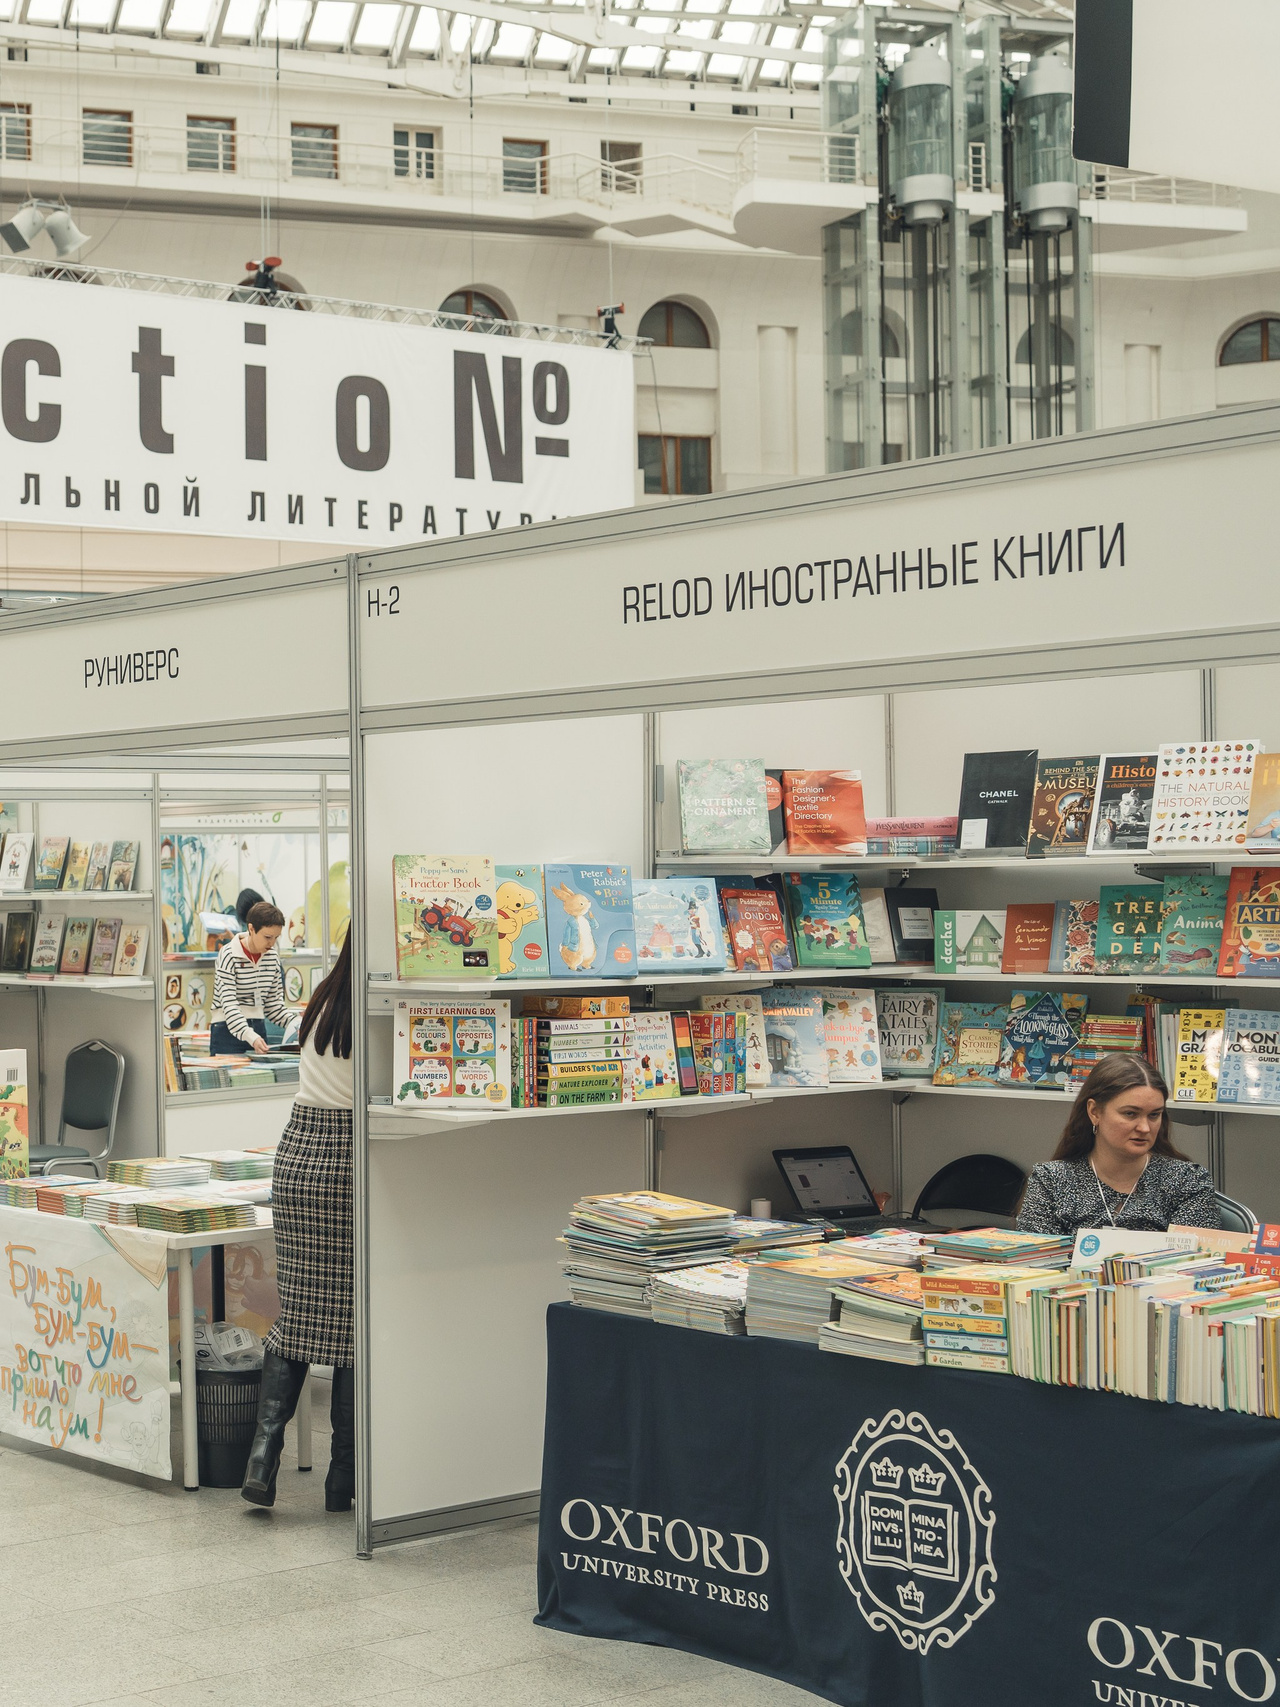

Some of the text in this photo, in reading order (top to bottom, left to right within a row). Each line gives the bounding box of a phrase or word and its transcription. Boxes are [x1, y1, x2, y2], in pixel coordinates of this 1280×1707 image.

[248, 490, 558, 536] ЛИТЕРАТУ
[623, 522, 1125, 624] RELOD ИНОСТРАННЫЕ КНИГИ
[84, 647, 179, 688] РУНИВЕРС
[1109, 765, 1156, 779] Histo
[791, 777, 807, 785] The
[792, 786, 824, 794] Fashion
[1160, 783, 1184, 794] THE
[1188, 781, 1250, 793] NATURAL
[792, 794, 836, 804] Designer's
[979, 789, 1019, 799] CHANEL
[694, 797, 756, 806] PATTERN &
[1157, 795, 1249, 808] HISTORY BOOK
[694, 806, 758, 816] ORNAMENT
[794, 812, 833, 821] Directory
[580, 870, 604, 879] Peter
[409, 877, 482, 888] Tractor Book
[593, 878, 627, 887] Rabbit's
[603, 888, 623, 898] Box
[817, 882, 831, 899] 5
[611, 897, 630, 907] Fun
[739, 898, 775, 907] Paddington's
[810, 897, 843, 905] Minute
[740, 913, 779, 921] LONDON
[940, 921, 953, 965] dacha
[882, 999, 922, 1016] FAIRY
[889, 1014, 928, 1029] TALES
[1028, 1012, 1051, 1021] Through
[1051, 1013, 1060, 1021] the
[553, 1039, 579, 1047] NUMBERS
[880, 1031, 924, 1047] MYTHS
[1236, 1031, 1277, 1045] MON
[638, 1043, 667, 1051] Activities
[961, 1040, 998, 1049] STORIES
[560, 1063, 619, 1073] BUILDER'S Tool Kit
[559, 1079, 609, 1089] NATURE EXPLORER
[559, 1092, 606, 1104] ON THE FARM
[1177, 1089, 1194, 1097] CLE
[1084, 1241, 1096, 1250] BIG
[1177, 1237, 1192, 1245] VERY
[1167, 1243, 1191, 1251] HUNGRY
[1249, 1264, 1268, 1275] the
[938, 1282, 960, 1290] Animals
[928, 1320, 944, 1328] Things
[943, 1339, 960, 1348] Bugs
[939, 1356, 963, 1366] Garden
[870, 1505, 903, 1522] DOMI
[911, 1512, 947, 1530] MINA
[560, 1498, 770, 1578] OXFORD
[874, 1535, 902, 1549] ILLU
[913, 1542, 945, 1559] MEA
[561, 1552, 770, 1613] UNIVERSITY PRESS
[1087, 1616, 1280, 1702] OXFO
